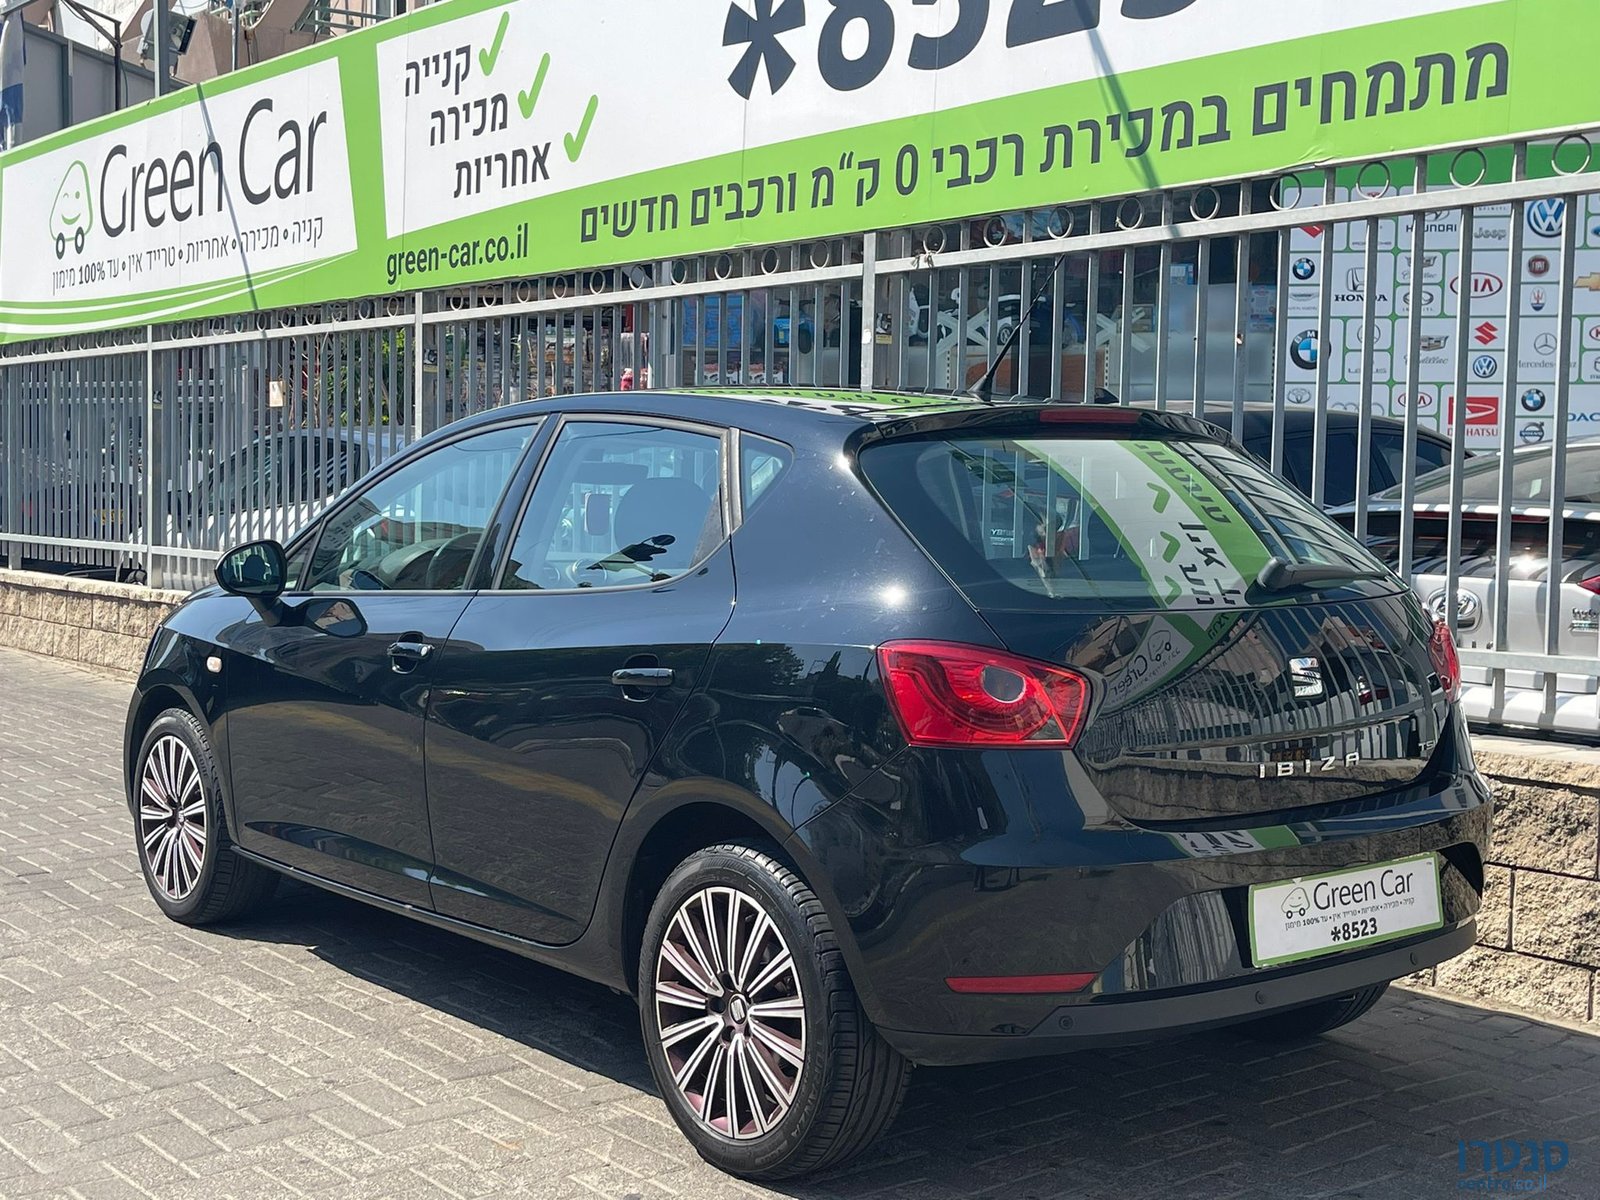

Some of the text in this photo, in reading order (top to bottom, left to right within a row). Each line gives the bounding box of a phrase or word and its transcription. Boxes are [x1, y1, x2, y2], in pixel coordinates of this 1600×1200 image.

[405, 45, 471, 97] קנייה
[1252, 42, 1509, 137] מתמחים
[430, 93, 508, 146] מכירה
[1040, 94, 1231, 173] במכירת
[100, 98, 327, 238] Green Car
[454, 142, 551, 199] אחריות
[895, 143, 920, 196] 0
[932, 133, 1024, 190] רכבי
[580, 192, 678, 244] חדשים
[690, 172, 796, 227] ורכבים
[387, 223, 529, 286] green-car.co.il
[1406, 223, 1457, 233] HUNDAI
[53, 216, 323, 296] קניה מכירה אחריות טרייד אין עד 100% מימון
[1334, 294, 1388, 302] HONA
[1447, 428, 1498, 437] DHATSU
[1259, 751, 1360, 779] IBIZA
[1313, 869, 1414, 910] Green Car
[1303, 917, 1320, 926] 100%
